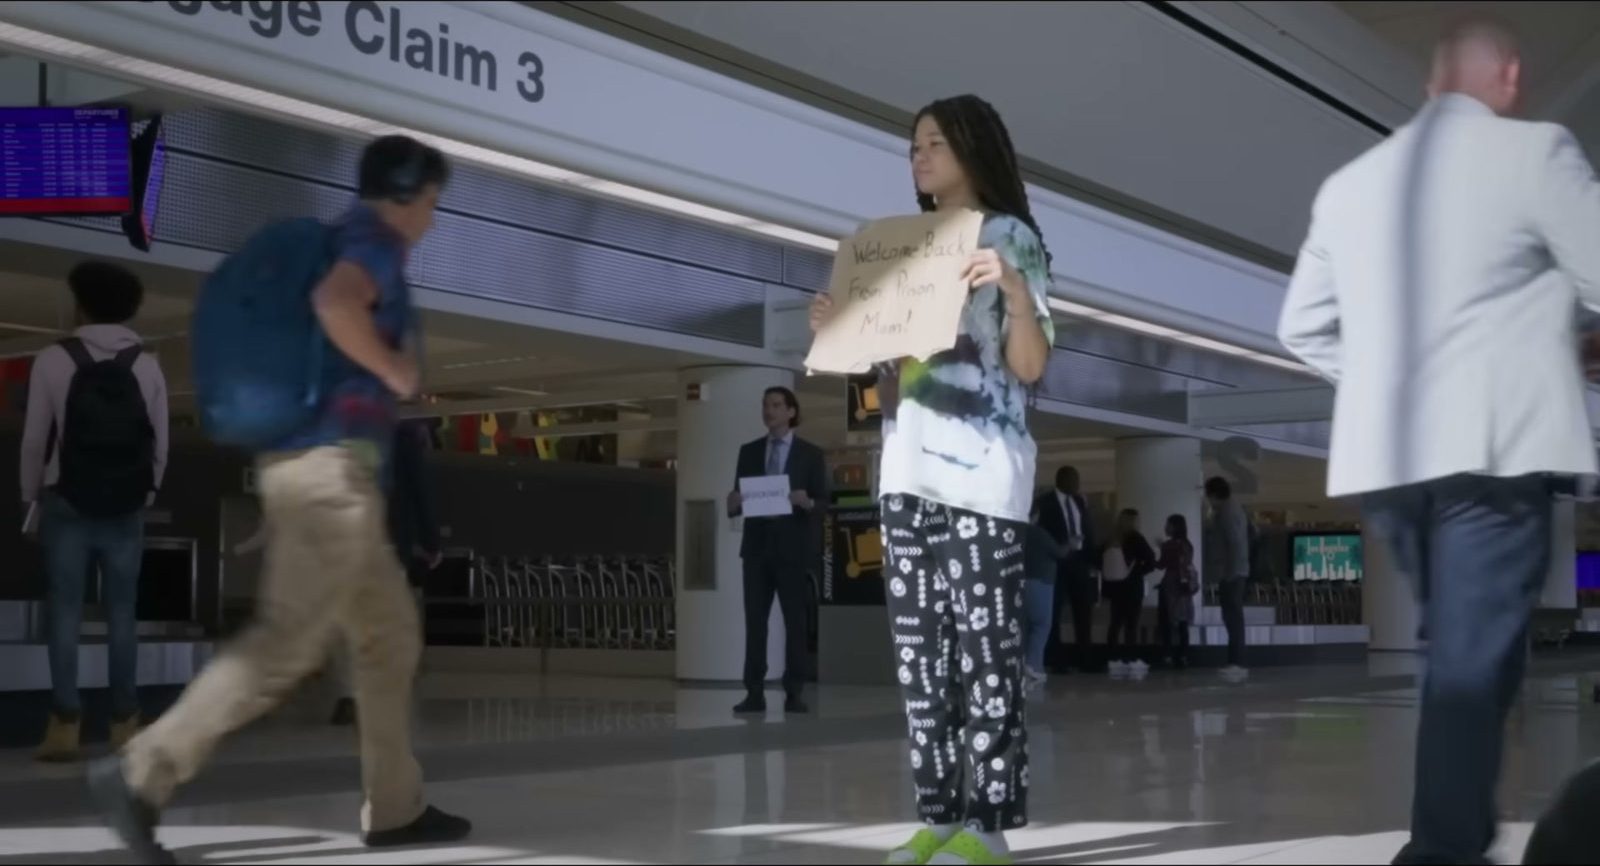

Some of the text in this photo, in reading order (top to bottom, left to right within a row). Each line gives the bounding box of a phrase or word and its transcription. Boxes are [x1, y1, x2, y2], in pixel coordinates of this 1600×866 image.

[345, 1, 497, 92] Claim
[516, 51, 545, 103] 3
[852, 231, 965, 265] Welcome Back
[897, 268, 936, 299] Prison
